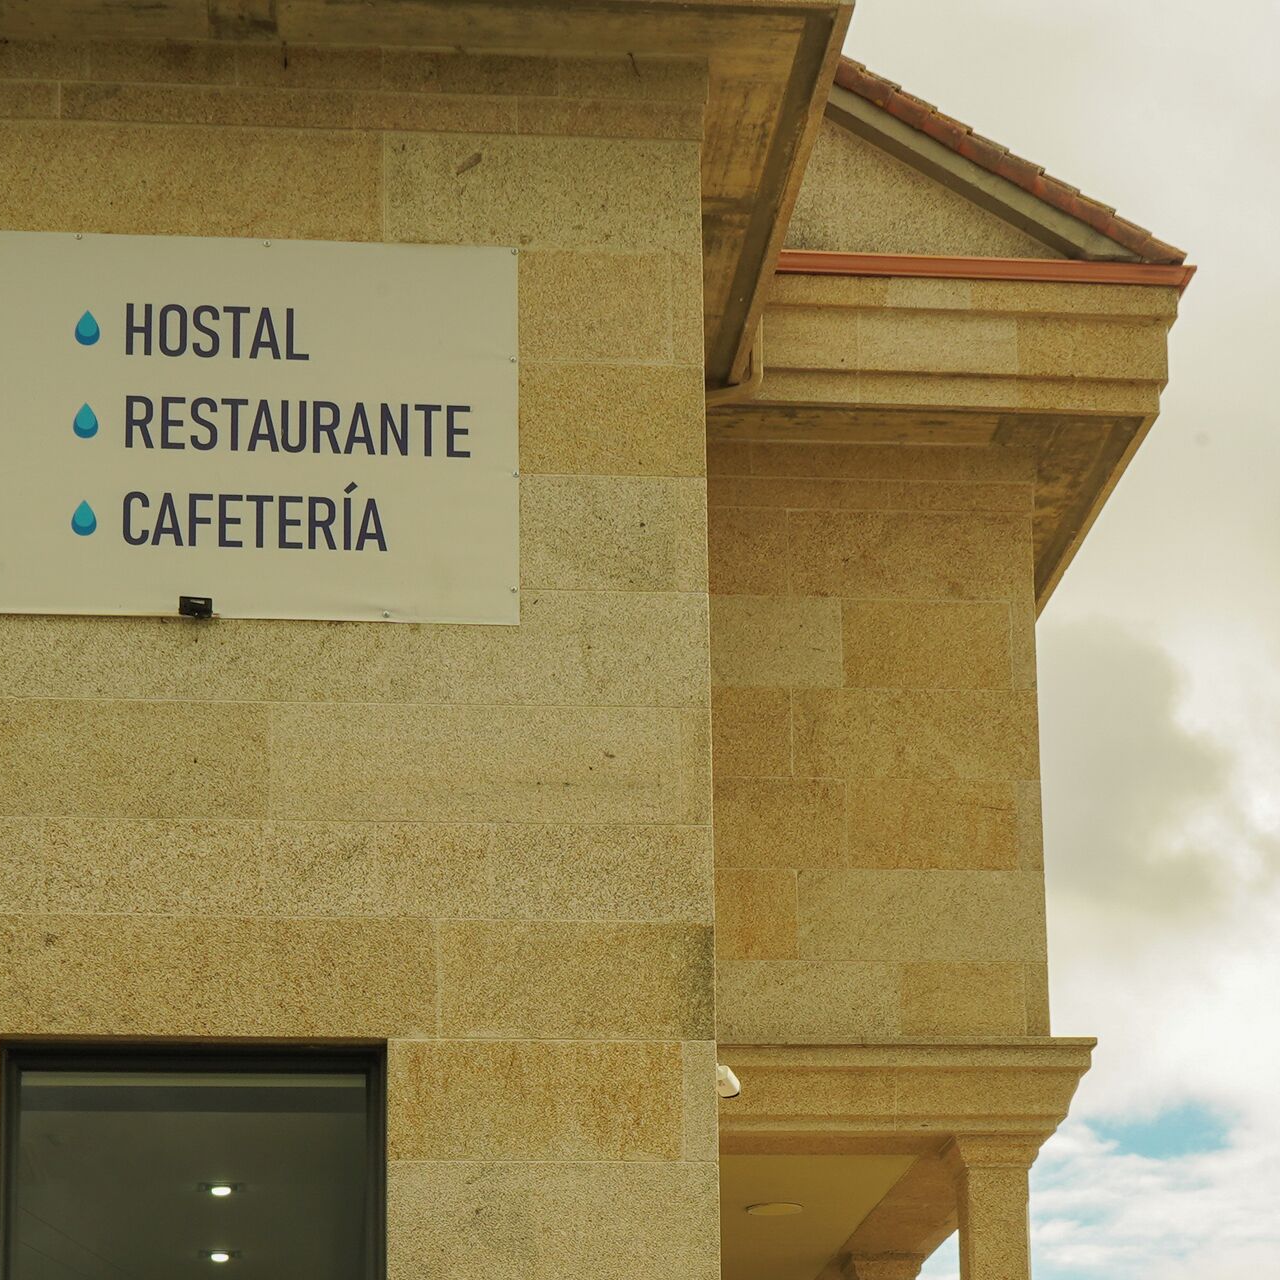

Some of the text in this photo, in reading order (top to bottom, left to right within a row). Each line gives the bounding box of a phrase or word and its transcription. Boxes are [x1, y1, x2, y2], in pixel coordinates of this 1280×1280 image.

[124, 302, 310, 361] HOSTAL
[124, 395, 471, 459] RESTAURANTE
[122, 481, 388, 552] CAFETERÍA
